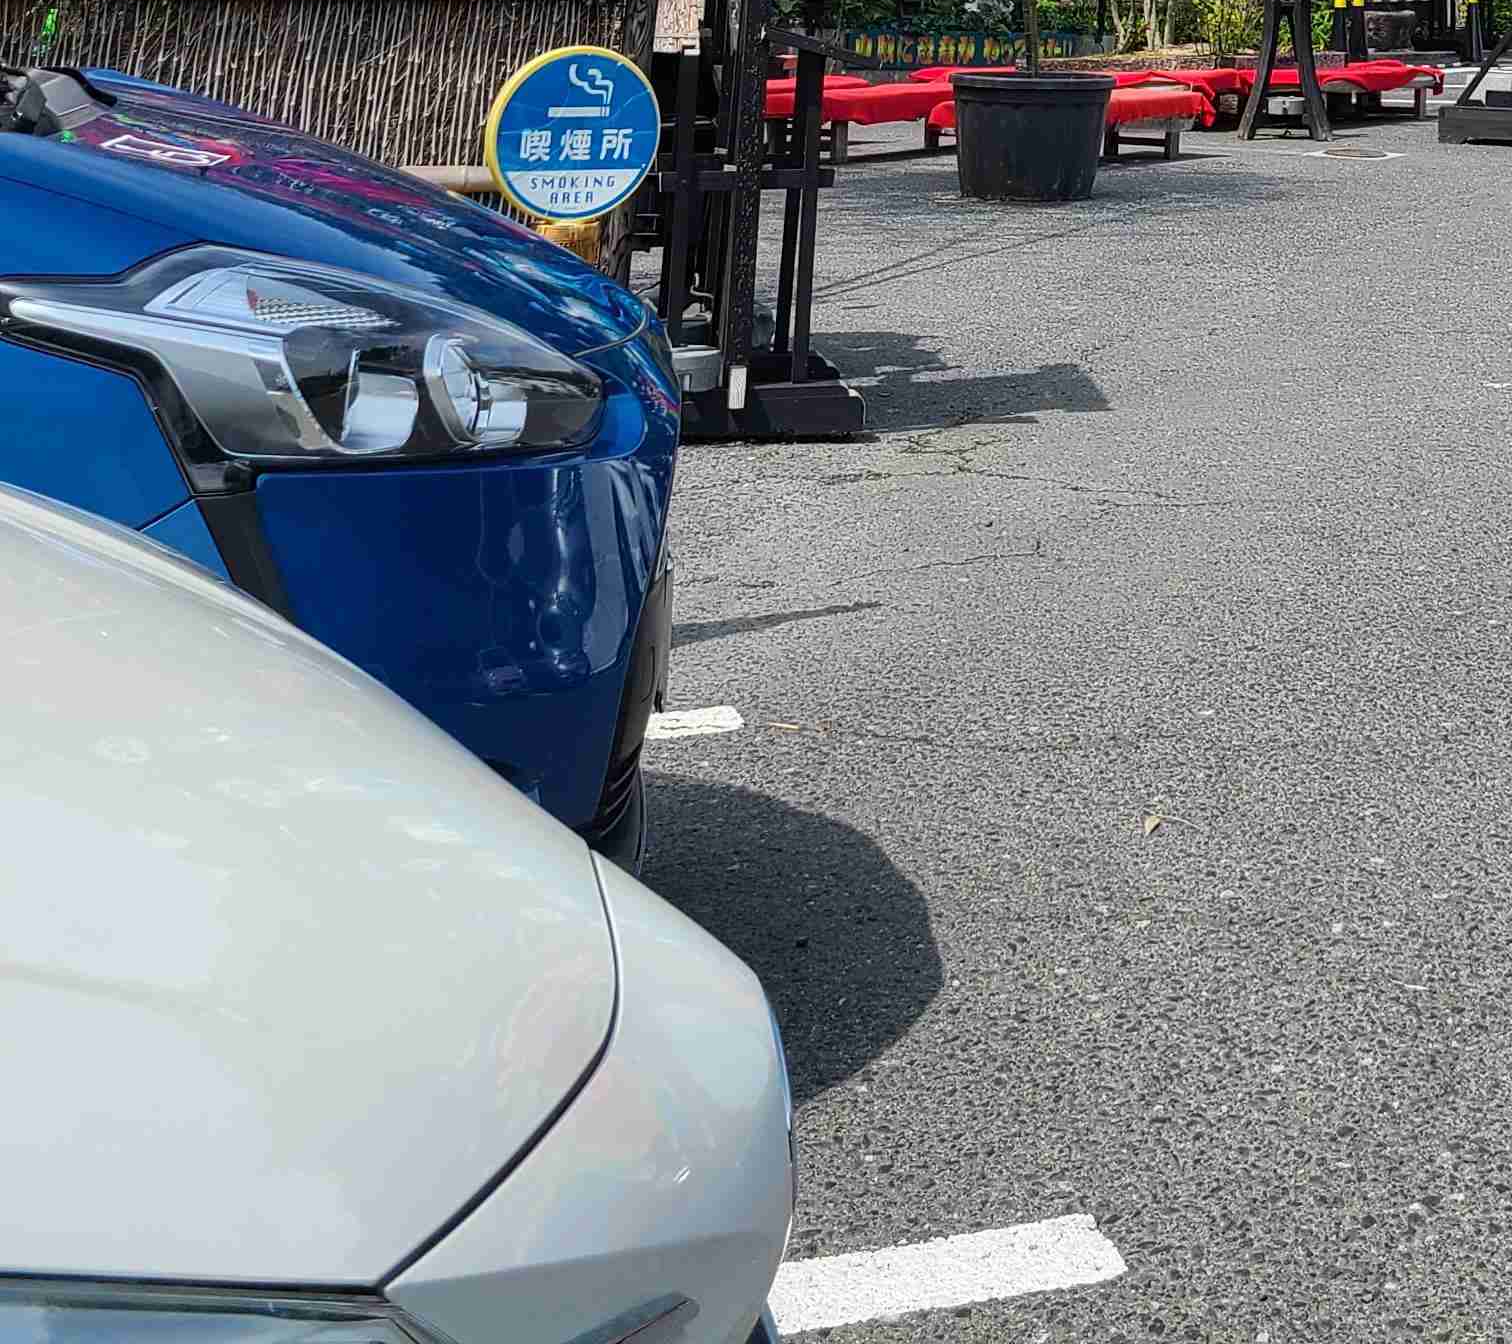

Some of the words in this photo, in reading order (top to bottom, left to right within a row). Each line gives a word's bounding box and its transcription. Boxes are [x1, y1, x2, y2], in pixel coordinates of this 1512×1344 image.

[519, 128, 633, 162] 喫煙所
[529, 175, 616, 190] SMOKING
[549, 191, 594, 204] AREA
